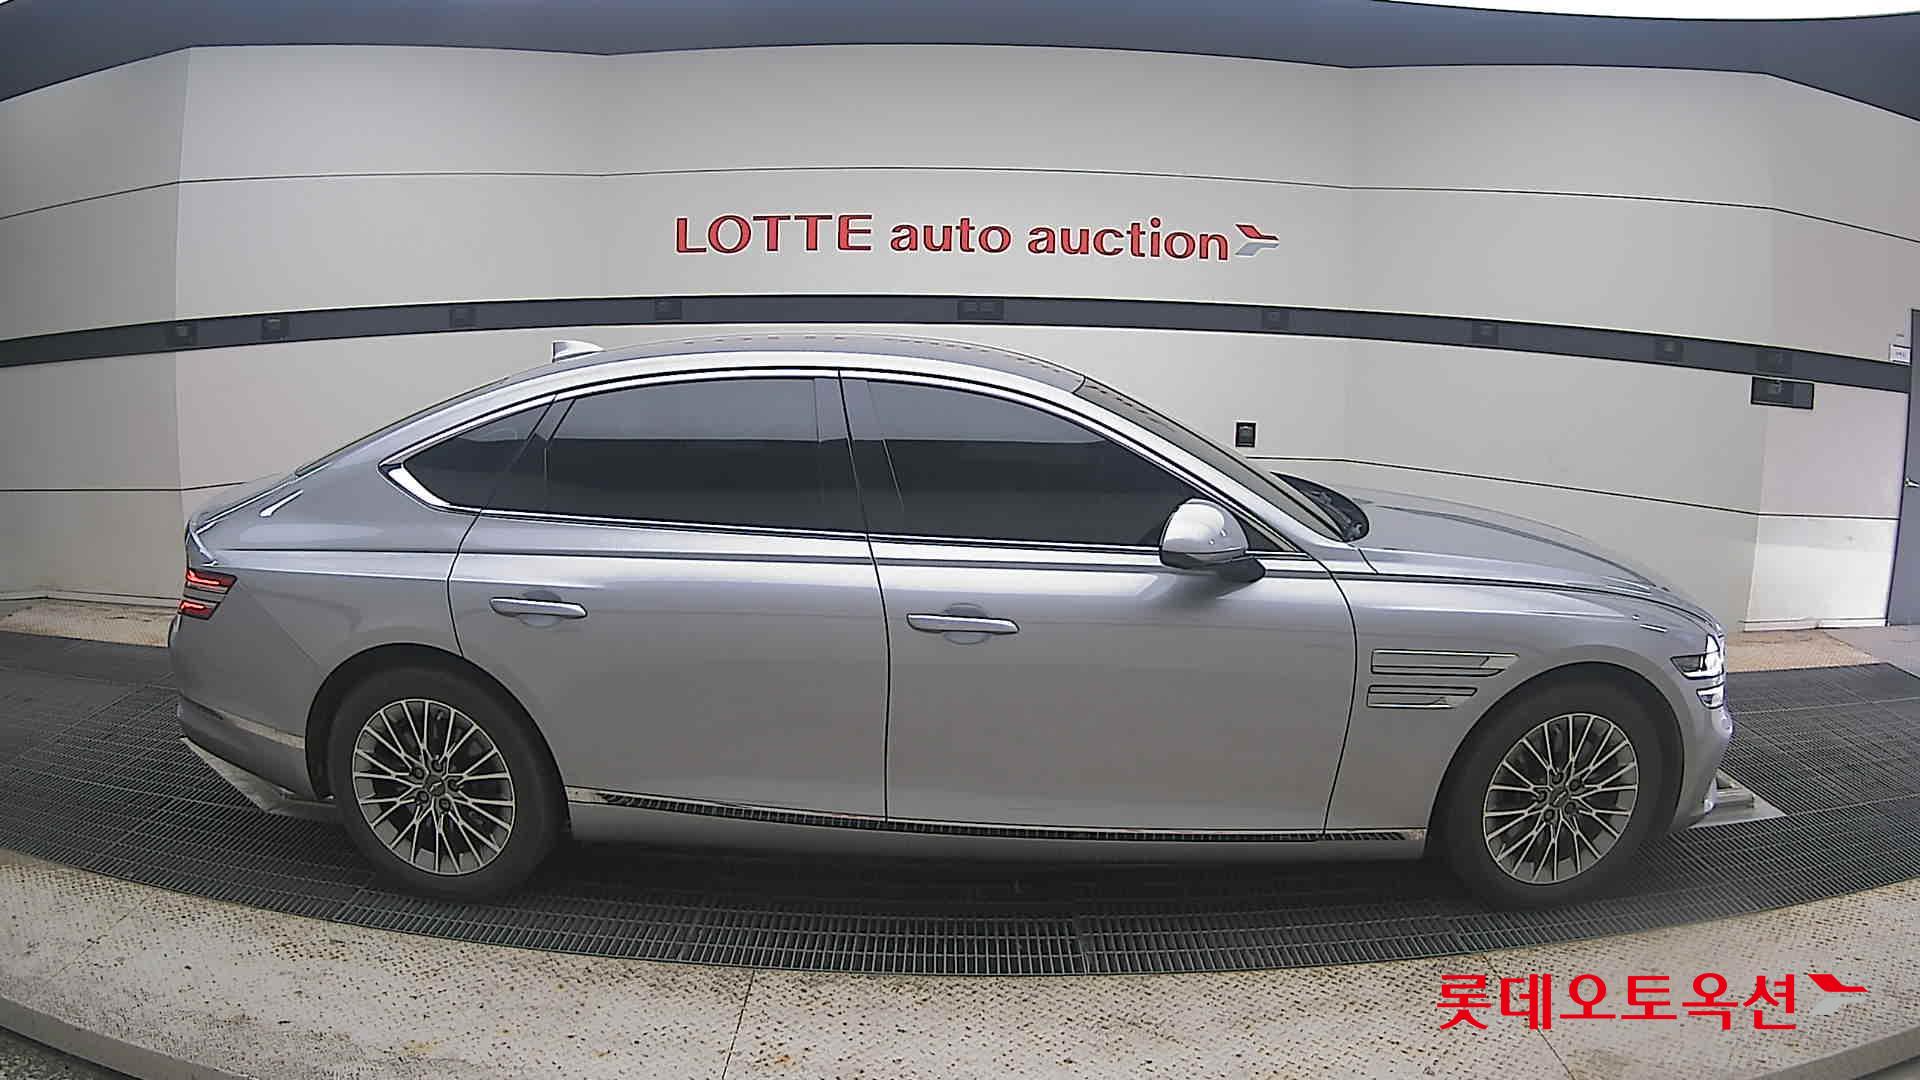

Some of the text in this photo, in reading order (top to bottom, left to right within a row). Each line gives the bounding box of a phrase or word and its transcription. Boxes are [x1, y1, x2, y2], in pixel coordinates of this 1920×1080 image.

[676, 215, 1229, 260] LOTTE auto auction
